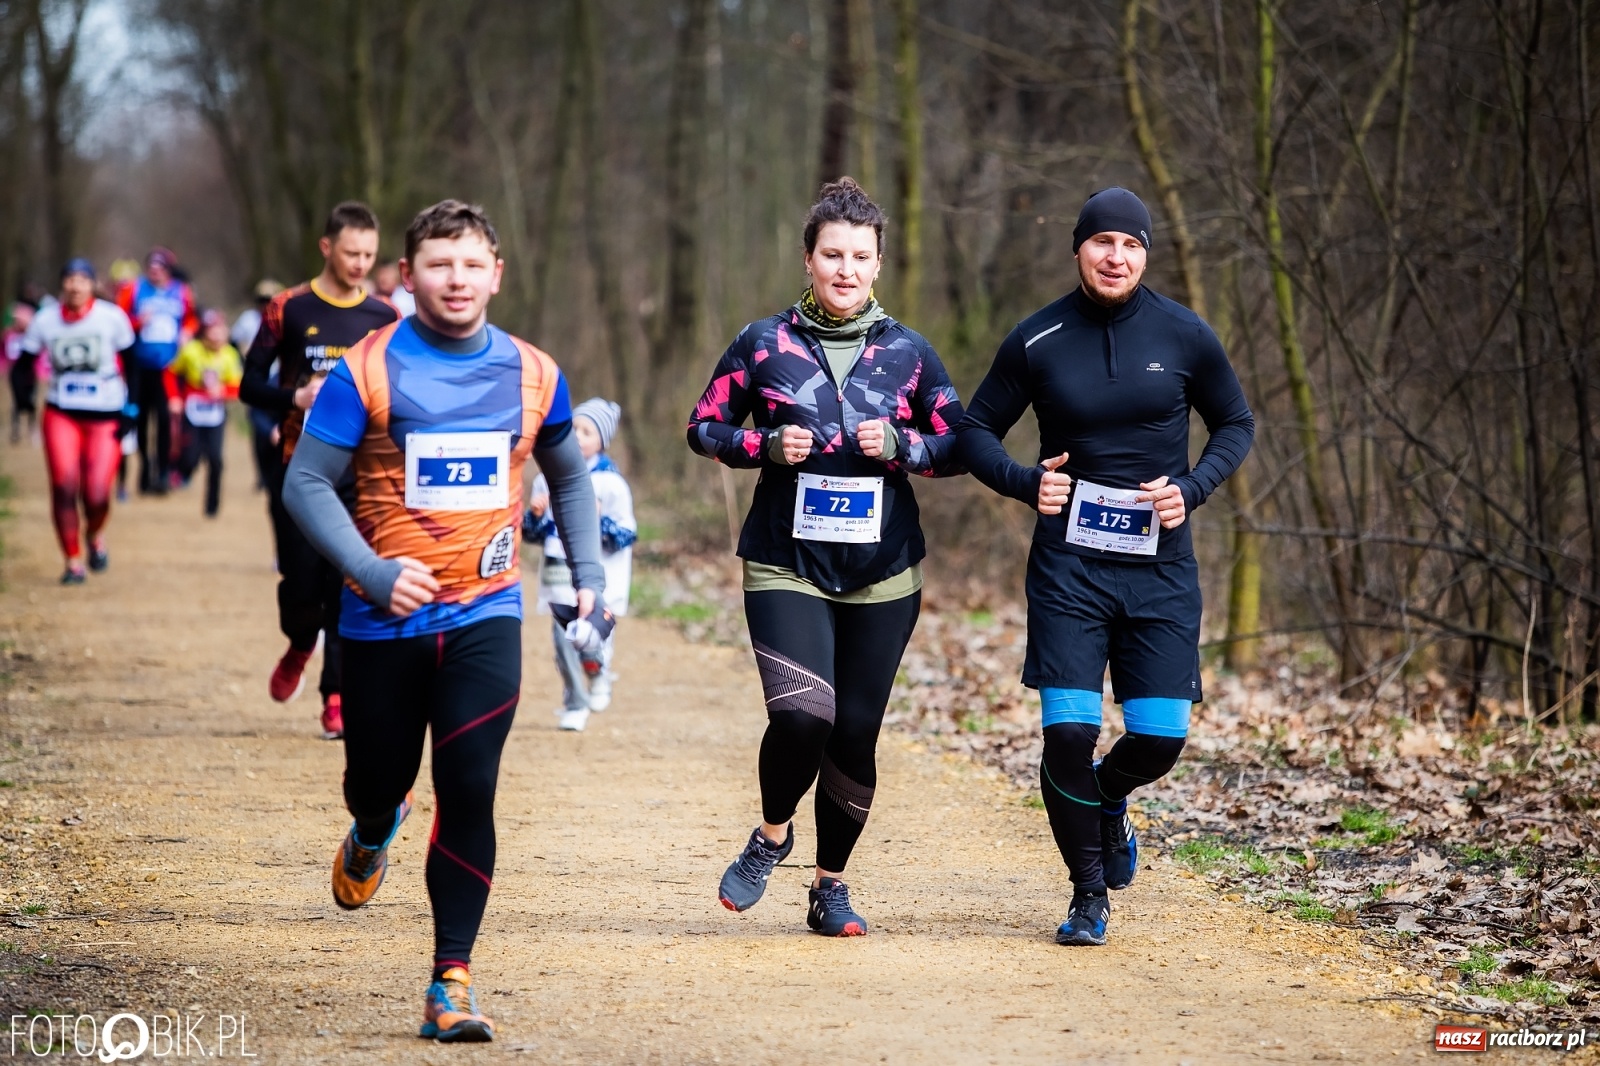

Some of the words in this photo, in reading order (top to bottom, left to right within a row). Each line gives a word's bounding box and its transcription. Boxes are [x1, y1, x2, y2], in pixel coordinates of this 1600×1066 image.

[446, 461, 472, 482] 73
[829, 496, 850, 513] 72
[1098, 511, 1131, 530] 175
